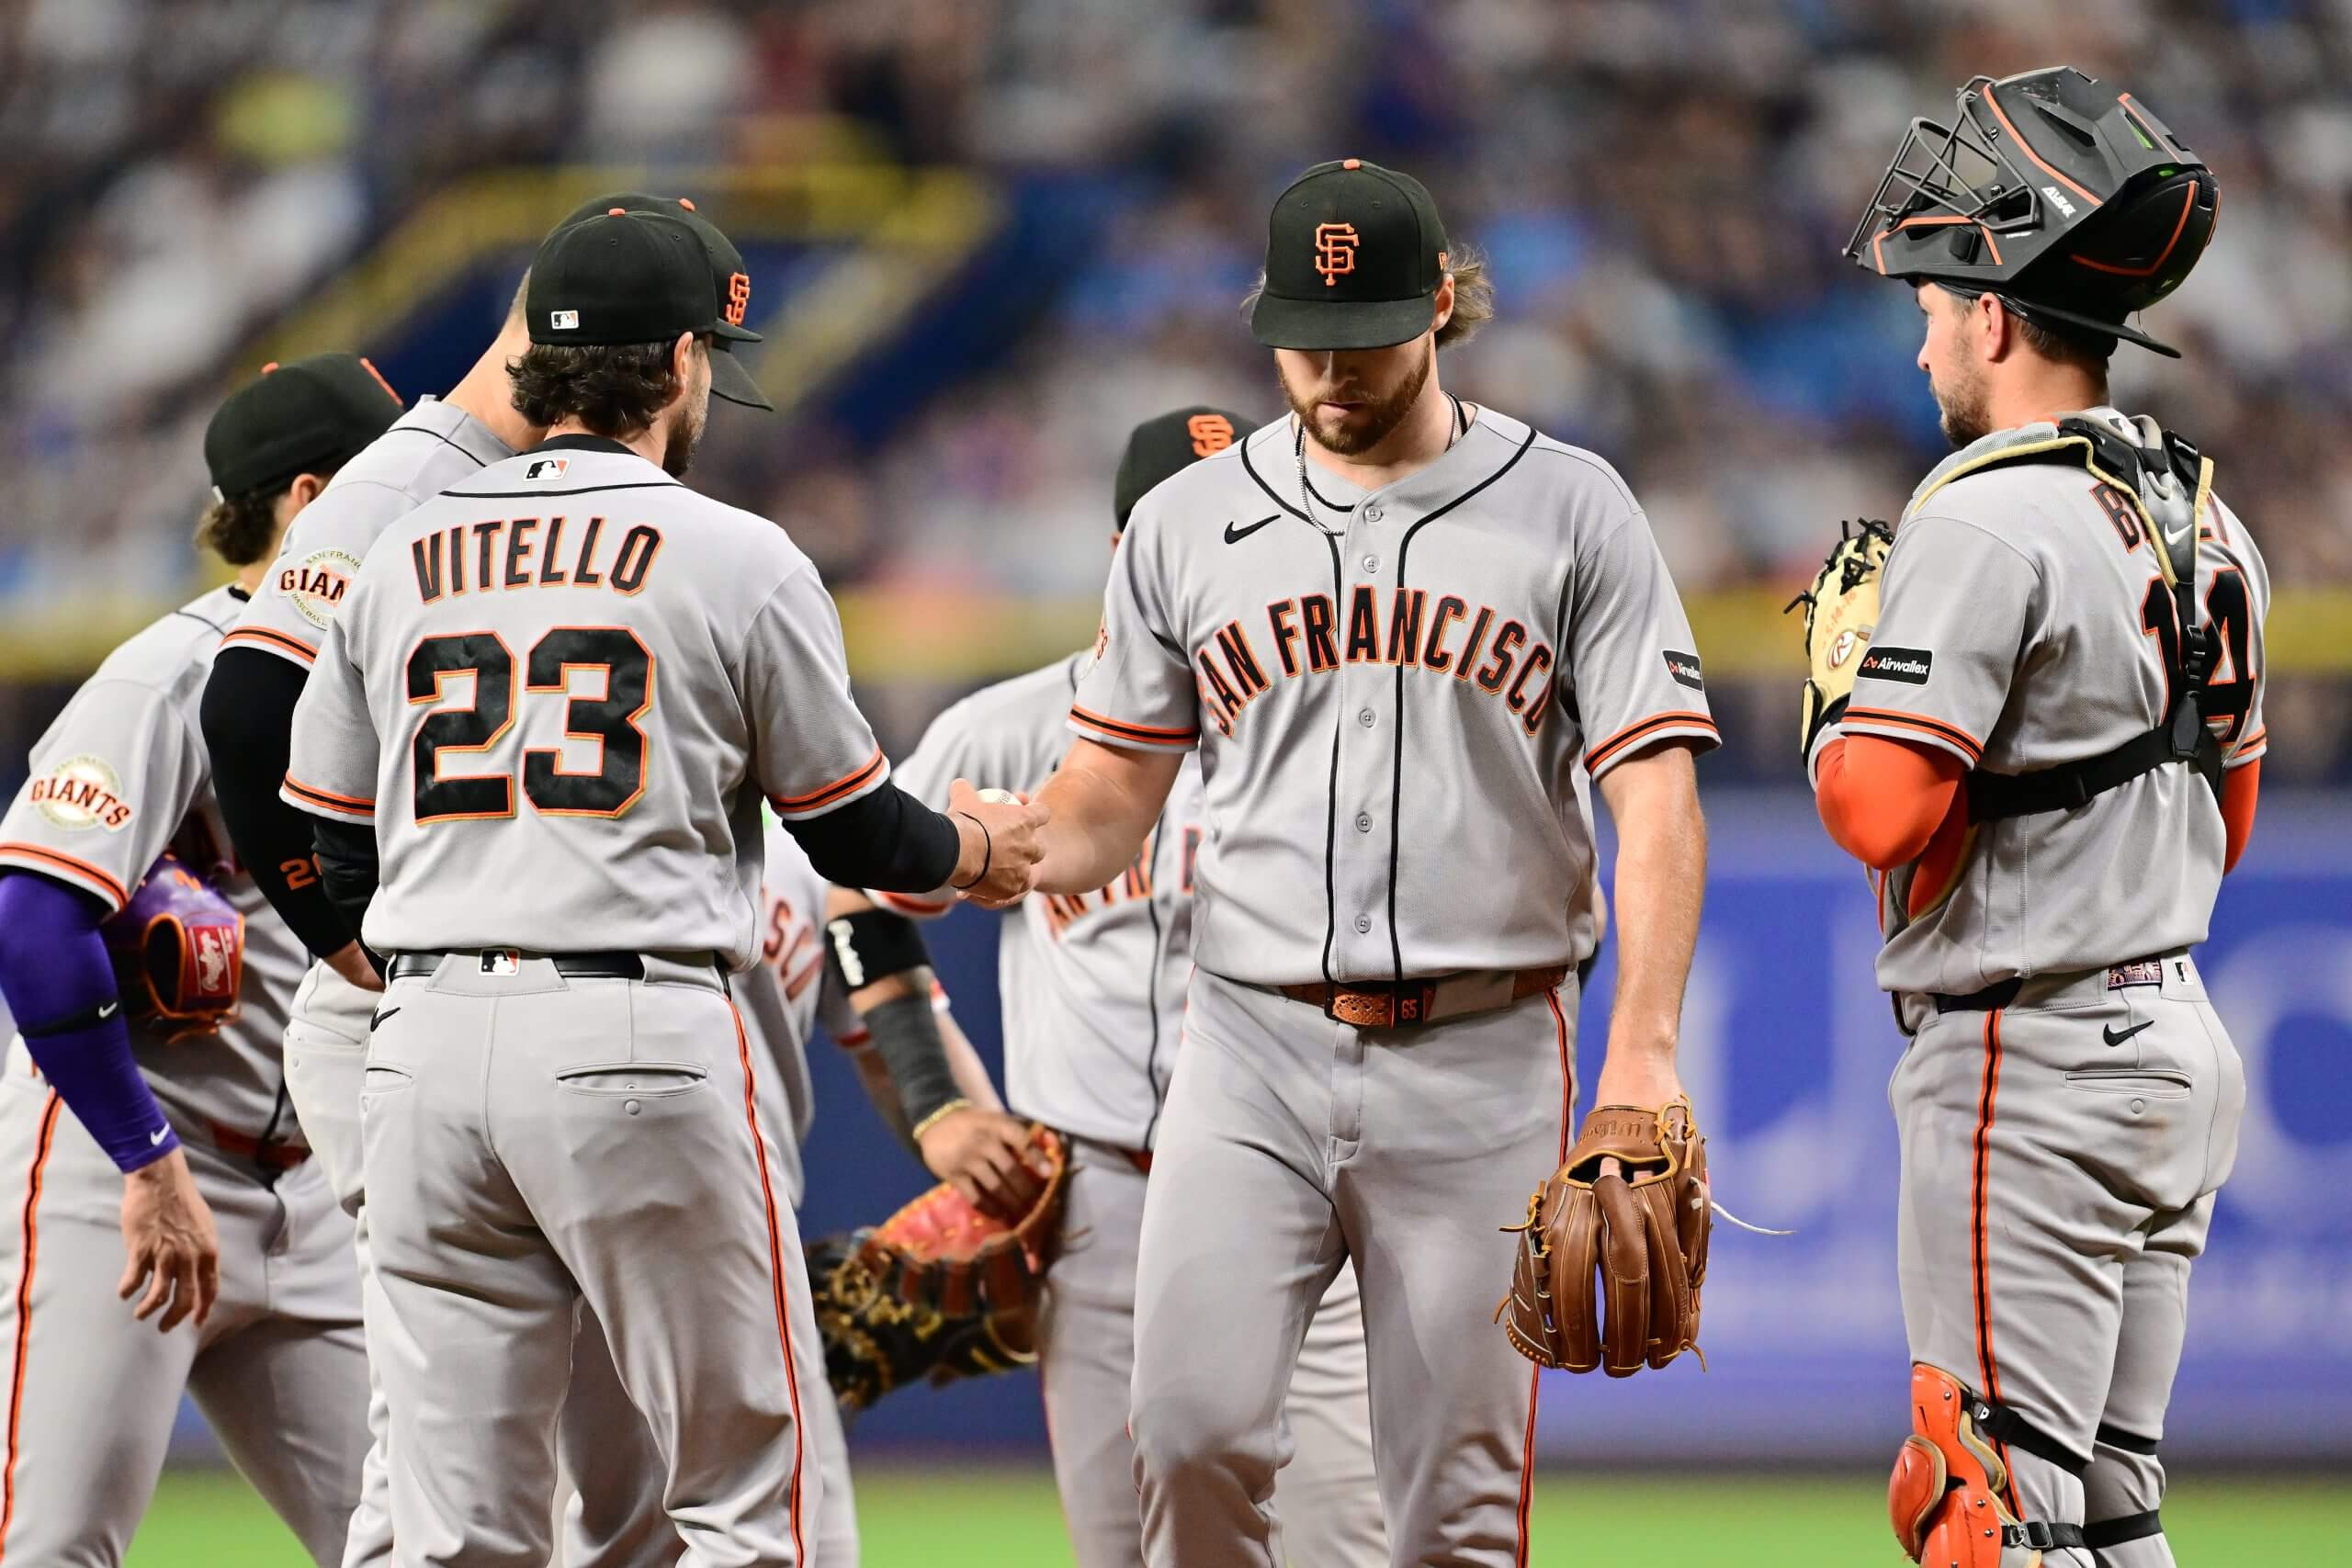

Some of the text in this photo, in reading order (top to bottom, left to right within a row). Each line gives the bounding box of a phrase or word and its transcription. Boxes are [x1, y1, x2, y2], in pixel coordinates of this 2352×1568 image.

[412, 515, 663, 604] VITELLO
[1876, 657, 1929, 675] Airwallex
[2140, 565, 2257, 749] 14
[405, 625, 656, 828] 23
[31, 777, 131, 827] GIANTS
[1400, 999, 1419, 1021] 65
